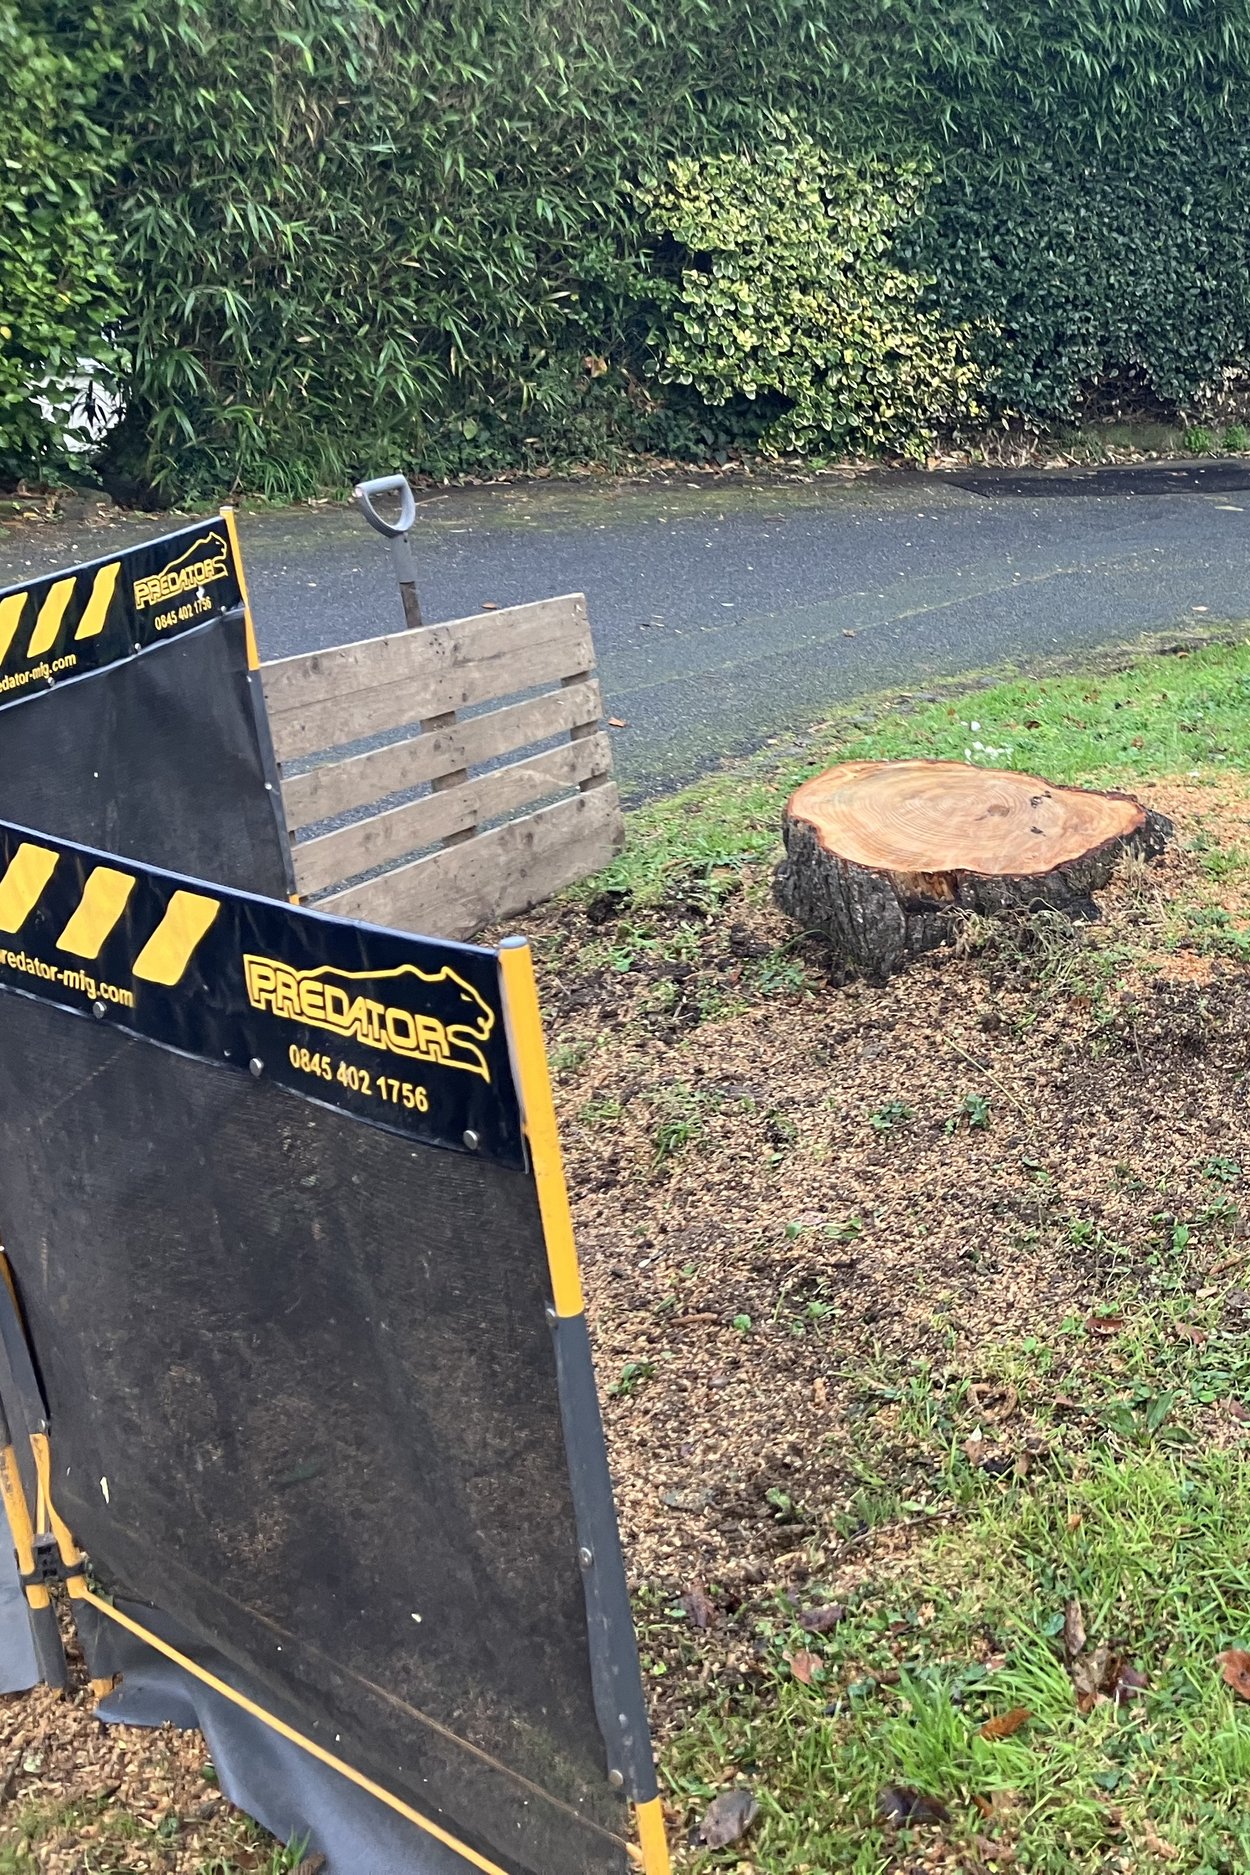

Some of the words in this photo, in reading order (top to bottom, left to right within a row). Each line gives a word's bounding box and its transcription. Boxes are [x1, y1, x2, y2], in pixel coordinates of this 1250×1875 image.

[133, 558, 215, 610] PREDATOR
[154, 610, 179, 631] 0845
[178, 603, 194, 621] 402
[194, 596, 212, 614] 1756
[243, 954, 451, 1063] PREDATOR
[289, 1044, 332, 1081] 0845
[336, 1060, 373, 1096] 402
[376, 1076, 429, 1112] 1756
